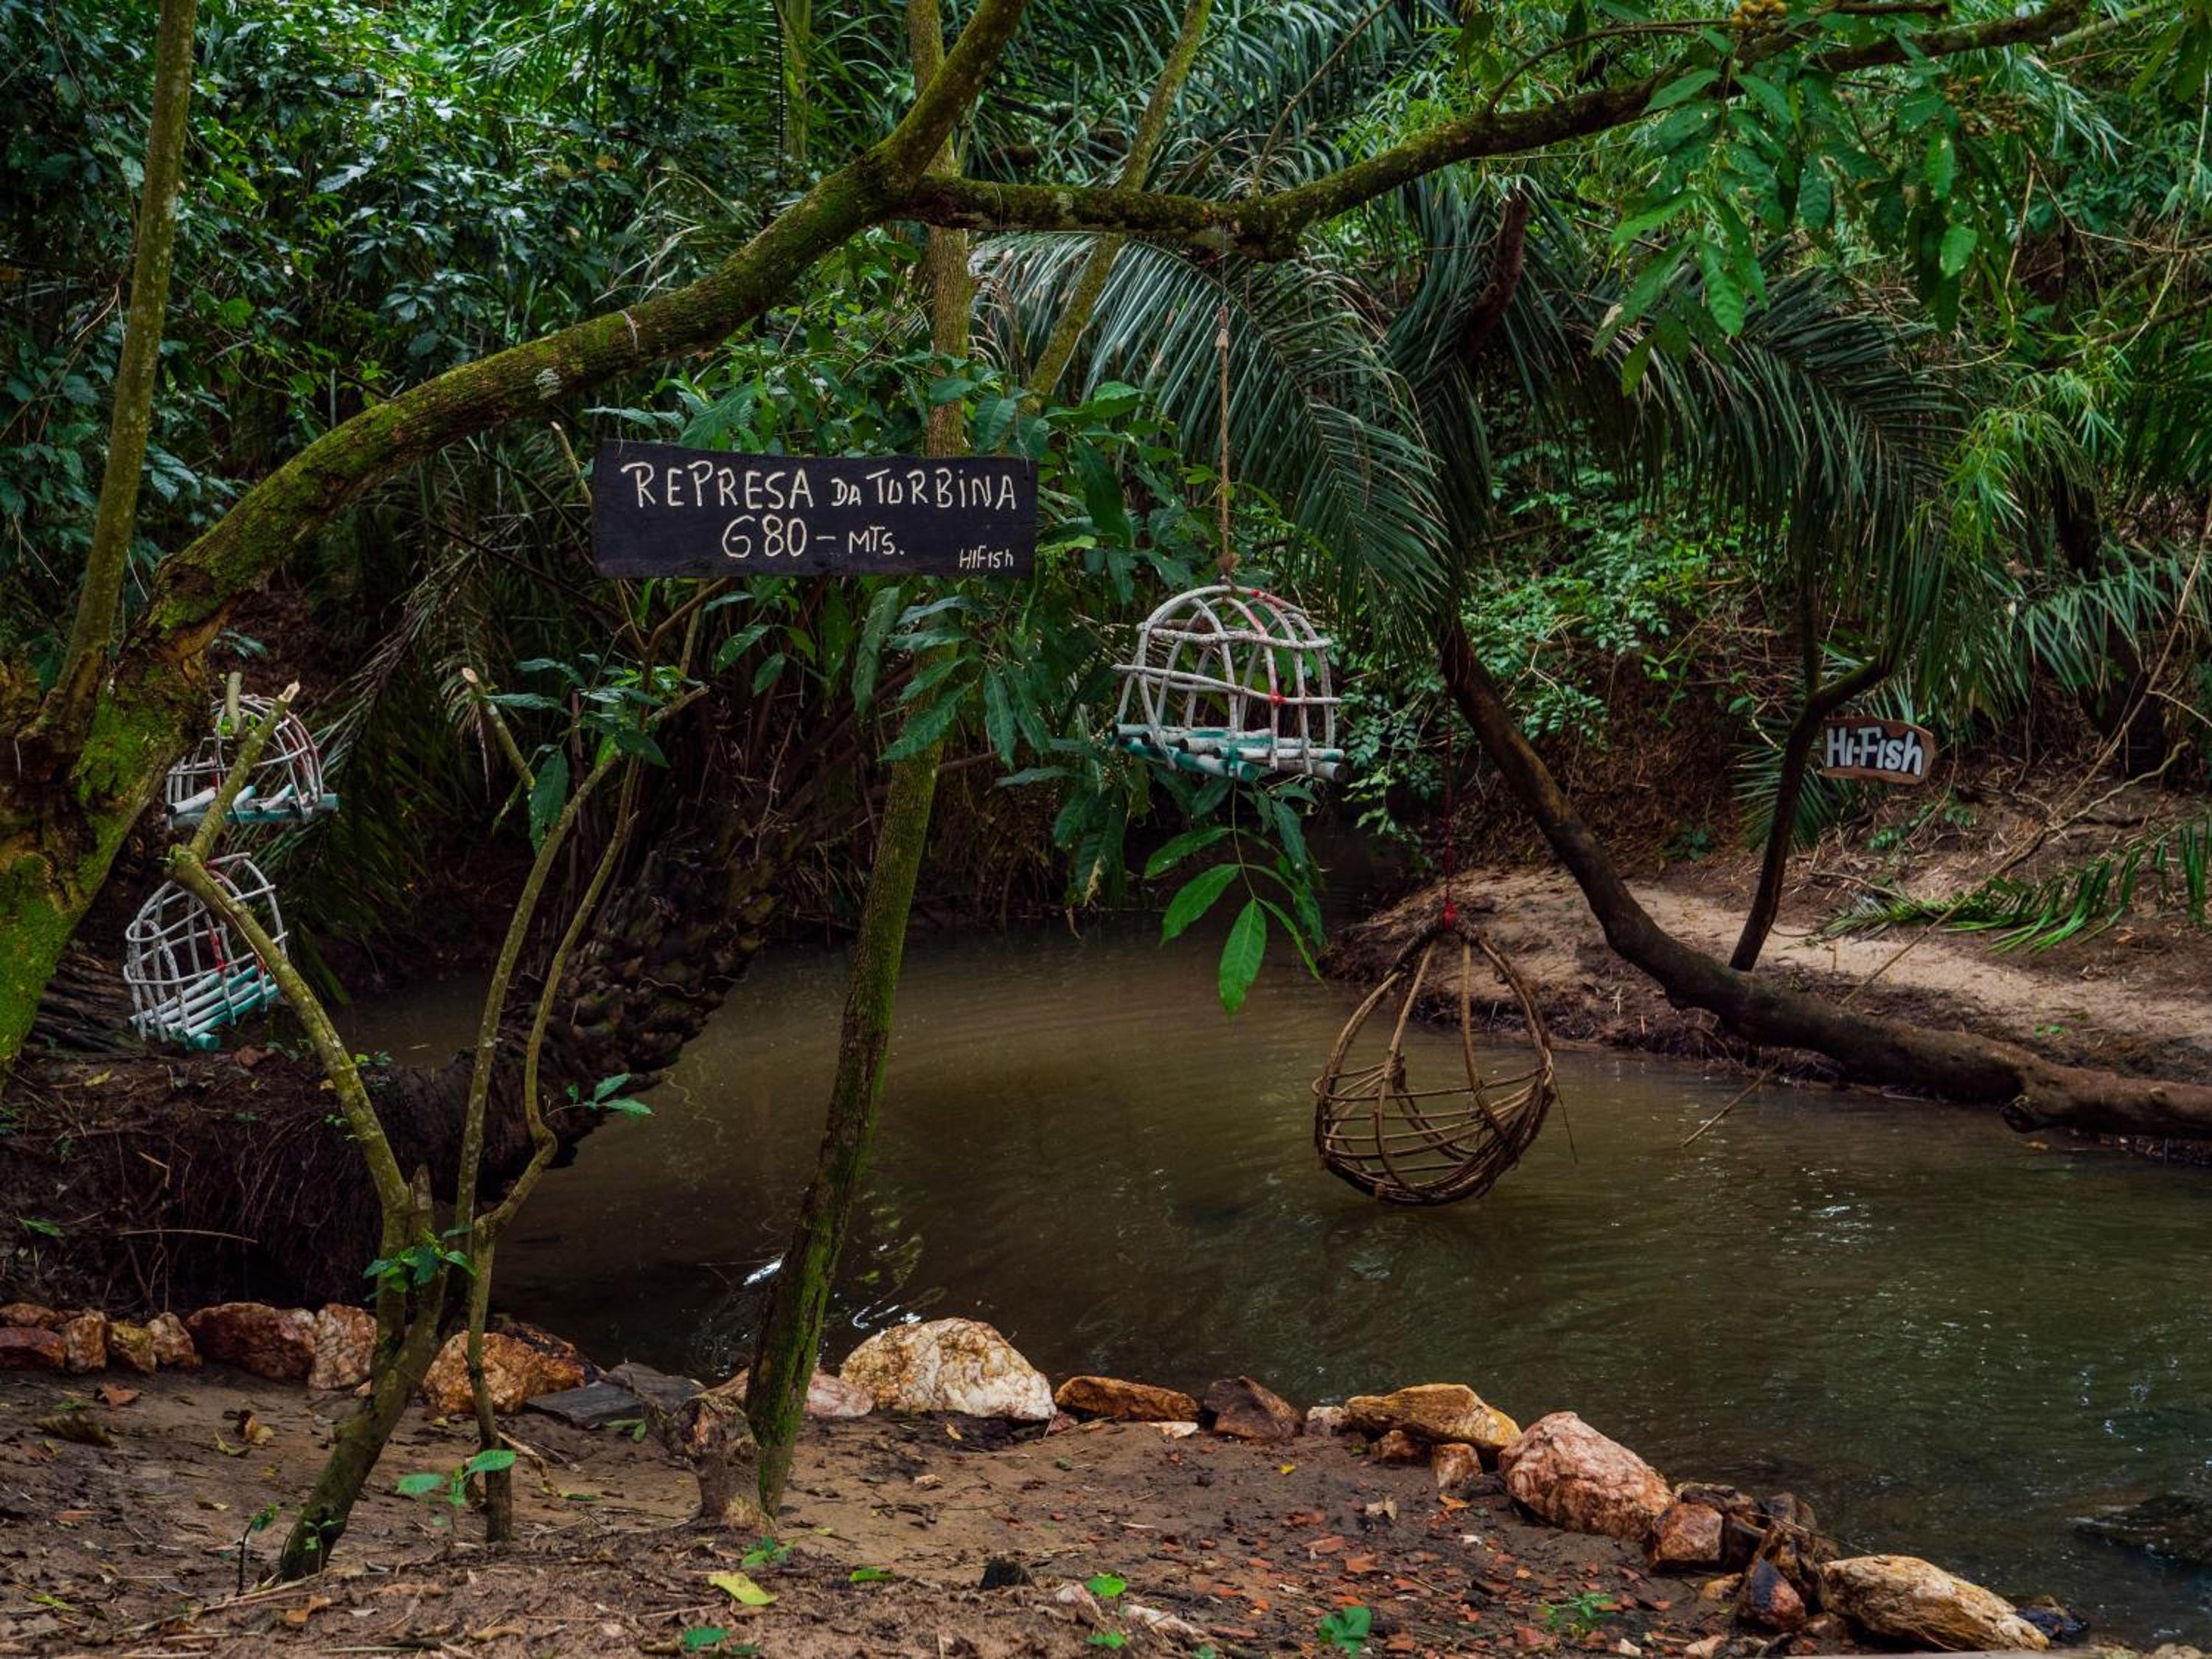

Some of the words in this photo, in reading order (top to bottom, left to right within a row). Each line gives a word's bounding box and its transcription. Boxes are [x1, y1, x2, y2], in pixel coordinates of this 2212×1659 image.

[621, 460, 814, 509] REPRESA
[831, 477, 862, 507] DA
[722, 514, 806, 558] 680
